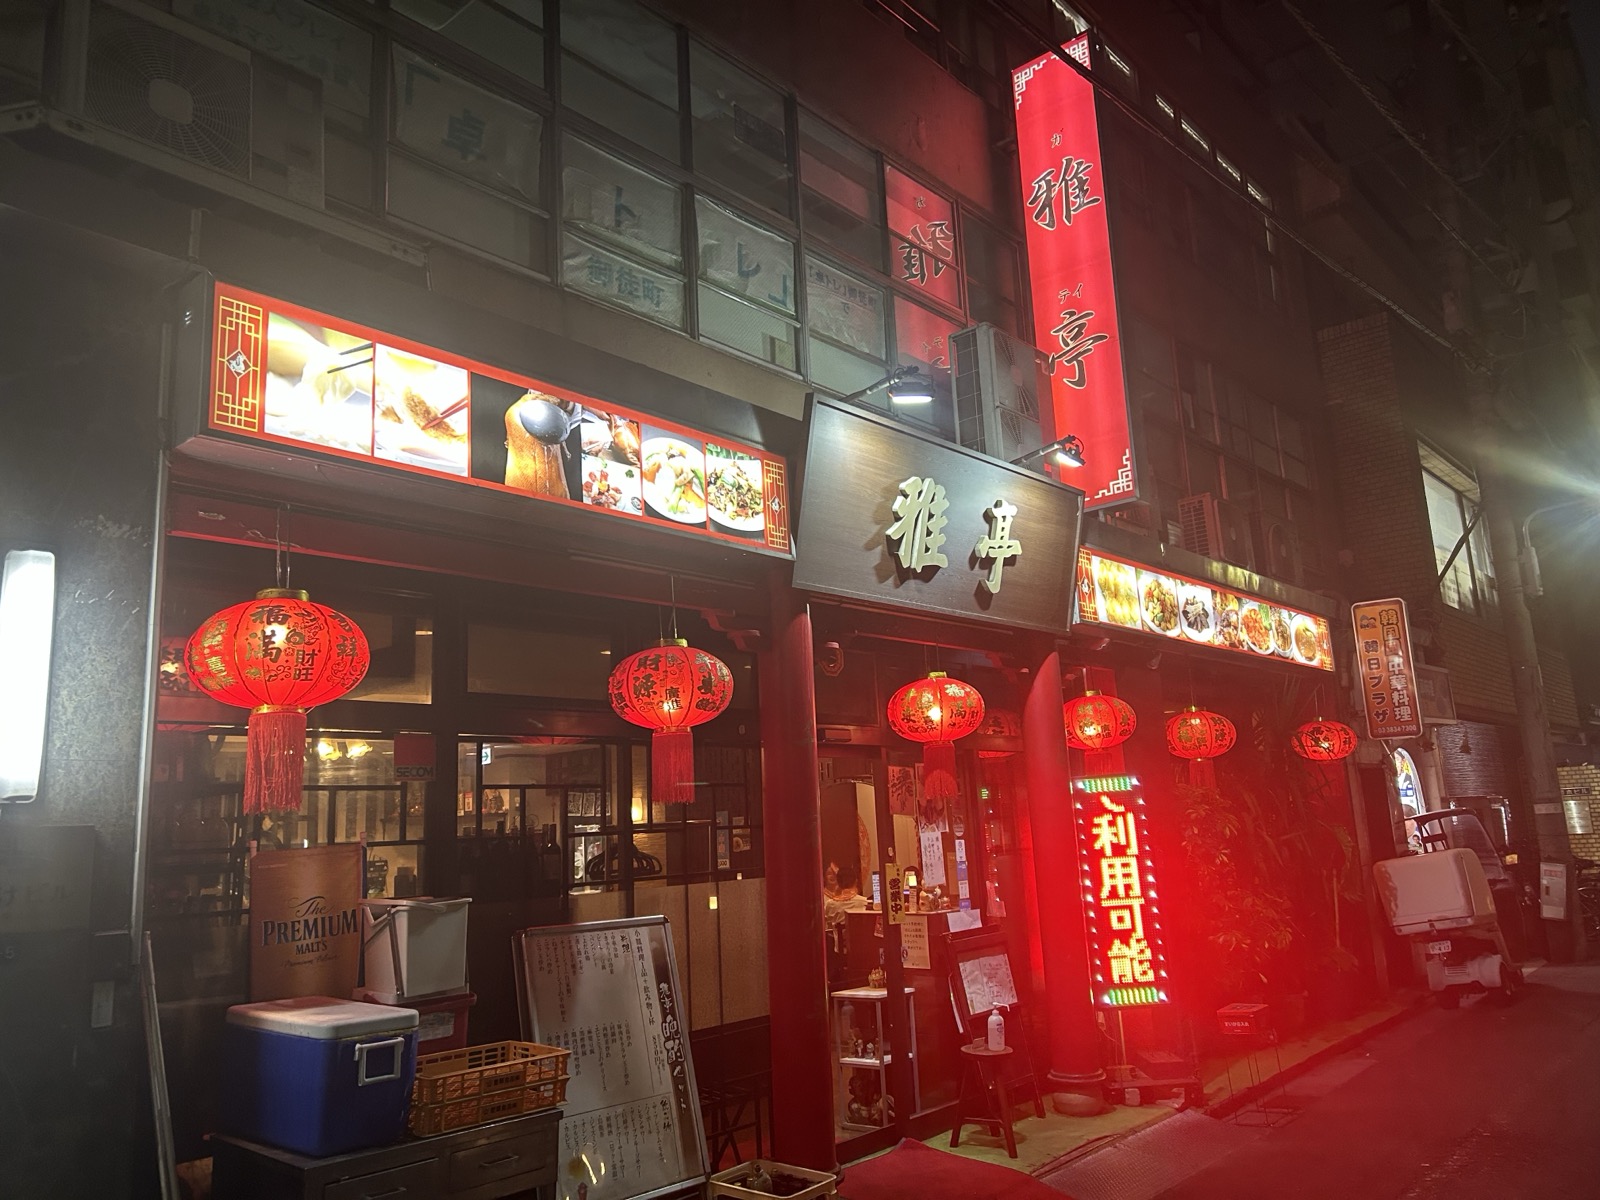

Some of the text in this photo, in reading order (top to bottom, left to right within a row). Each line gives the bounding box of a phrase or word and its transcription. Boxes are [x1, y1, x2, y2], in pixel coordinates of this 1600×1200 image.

[1026, 157, 1109, 390] 雅亭
[885, 476, 1022, 594] 雅亭
[1363, 640, 1390, 724] 韓日プラザ
[396, 766, 434, 777] SECOM
[289, 895, 336, 918] The
[889, 877, 903, 914] 営業中
[1091, 794, 1155, 984] 利用可能
[262, 908, 358, 946] PREMIUM
[295, 939, 328, 955] MALT'S
